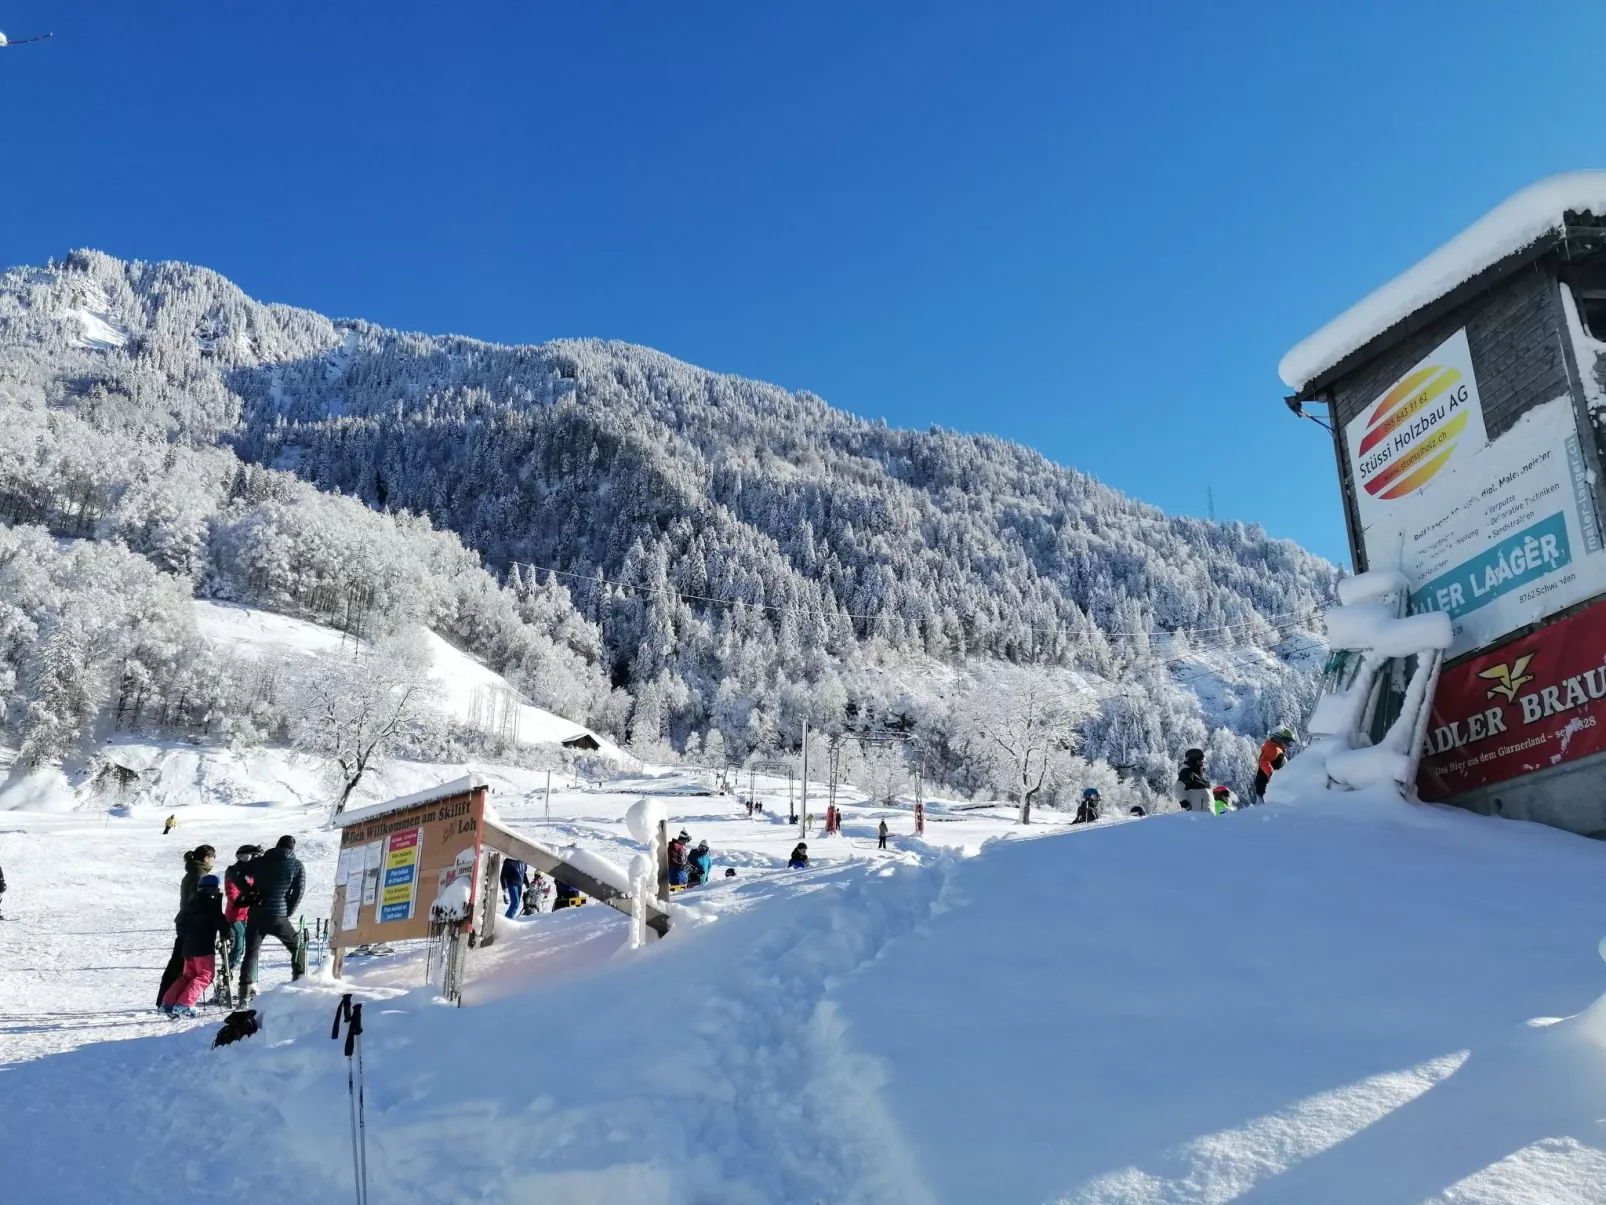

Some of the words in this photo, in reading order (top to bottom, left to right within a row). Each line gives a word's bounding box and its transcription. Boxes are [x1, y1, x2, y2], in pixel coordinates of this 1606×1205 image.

[1359, 443, 1392, 479] Stüssi
[1394, 406, 1446, 452] Holzbau
[1449, 384, 1469, 412] AG
[1383, 418, 1396, 432] 055
[1396, 407, 1409, 423] 643
[1409, 400, 1418, 412] 31
[1419, 392, 1429, 405] 62
[1383, 431, 1448, 483] www.stuessiholz.ch
[1566, 437, 1598, 550] maler-laager.ch
[1519, 590, 1536, 604] 8762
[1422, 706, 1508, 758] ADLER
[1450, 759, 1466, 772] Bier
[1468, 757, 1479, 768] aus
[1480, 750, 1497, 763] dem
[1498, 732, 1546, 757] Glarnerland
[366, 815, 420, 838] Willkommen
[421, 812, 435, 824] am
[438, 801, 471, 821] Skilift
[458, 818, 476, 834] Loh
